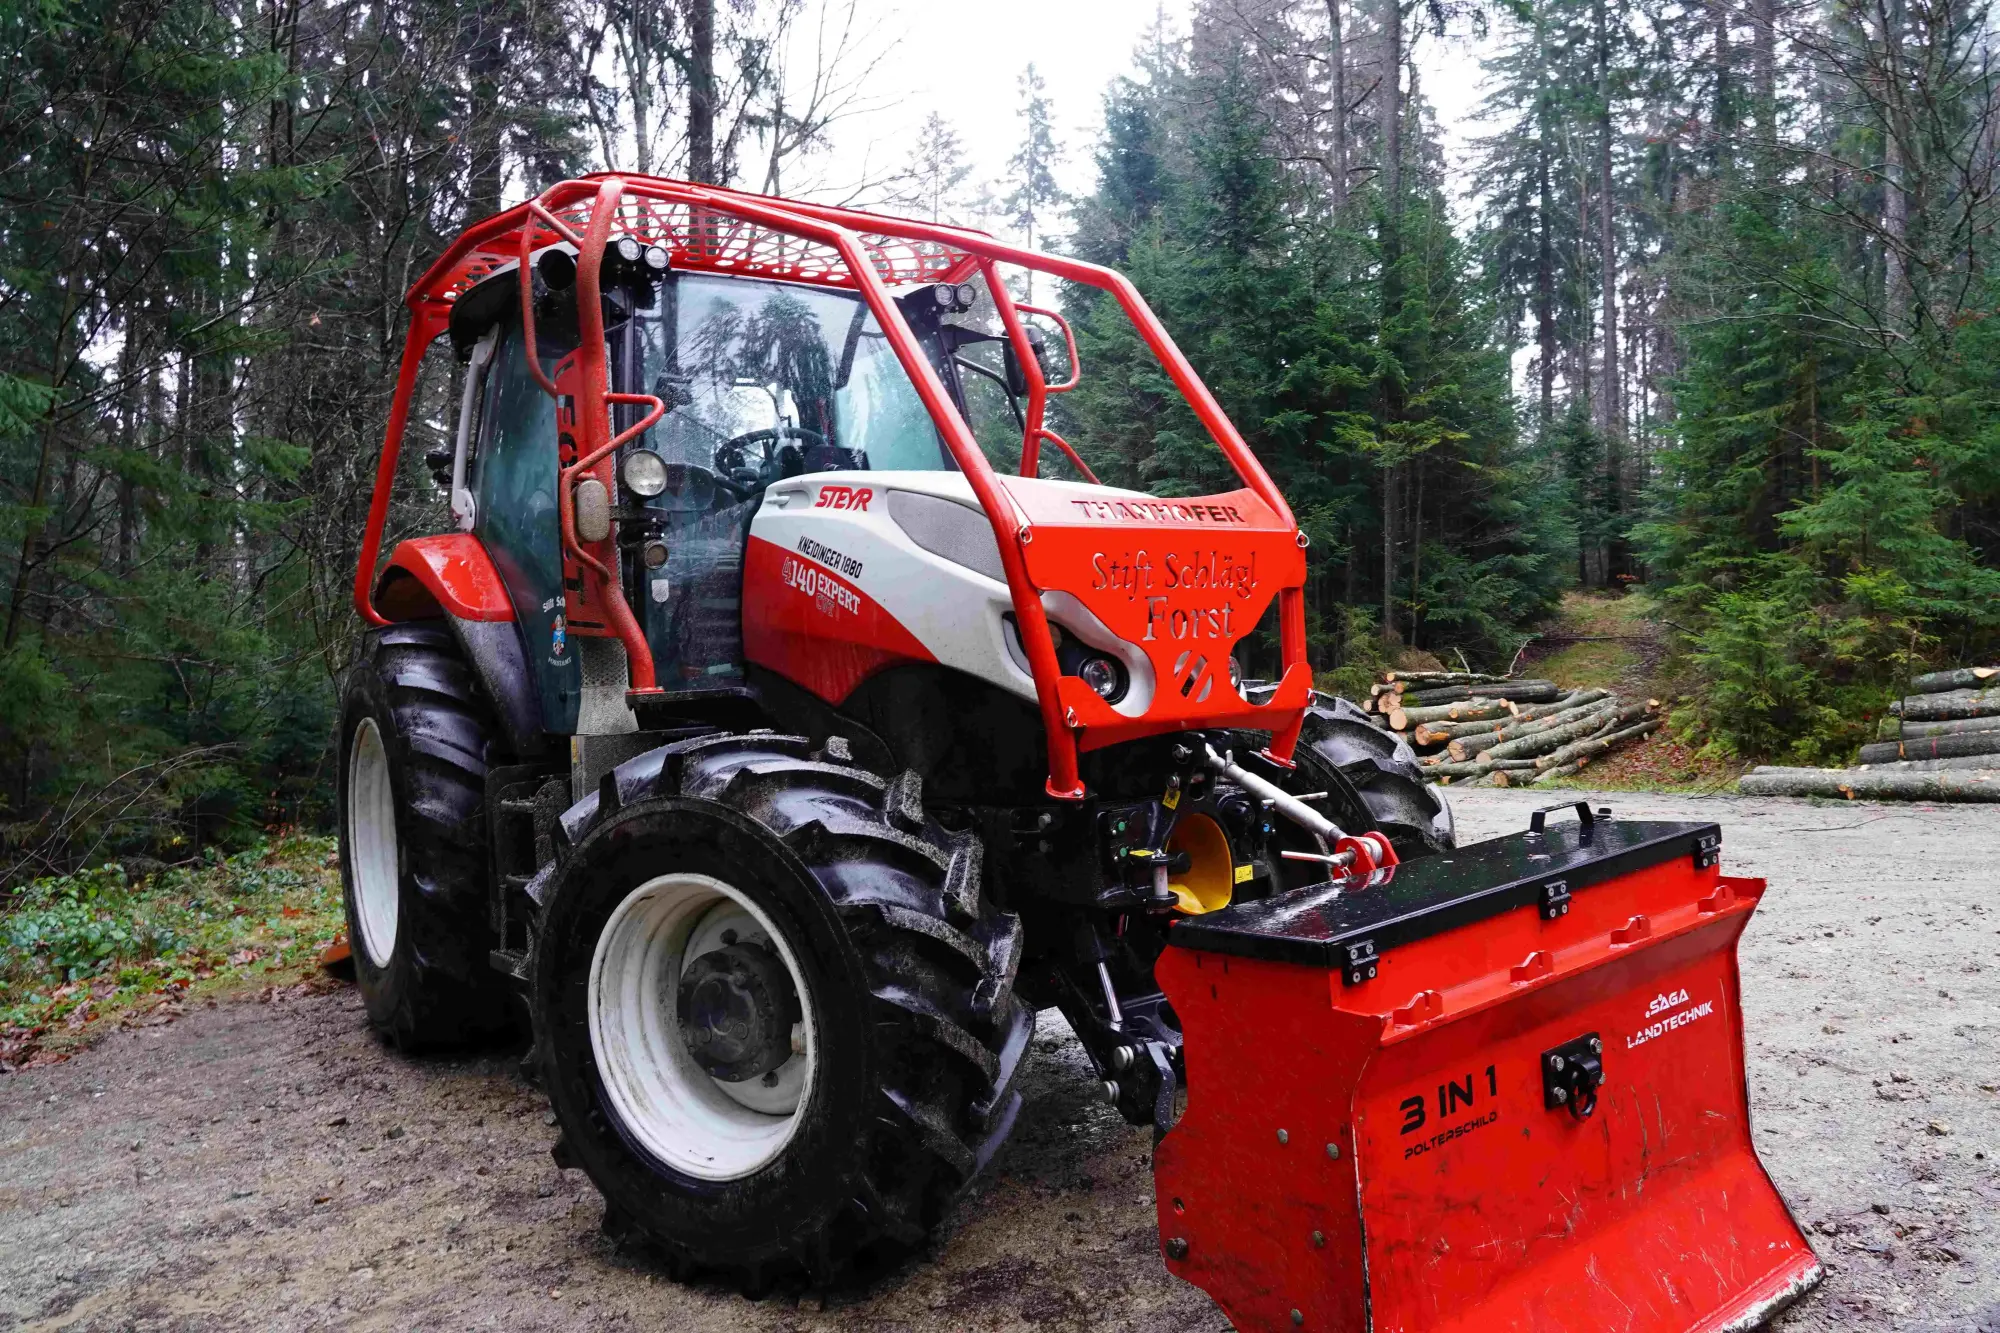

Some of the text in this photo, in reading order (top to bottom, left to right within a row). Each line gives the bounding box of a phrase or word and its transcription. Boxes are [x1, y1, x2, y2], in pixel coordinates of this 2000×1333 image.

[815, 485, 873, 512] STEYR
[1071, 500, 1246, 524] THANHOFER
[796, 535, 863, 579] KNEIDINGER 1880
[1092, 550, 1259, 602] Stift Schlägl
[817, 573, 861, 616] EXPERT
[1142, 596, 1236, 641] Forst
[1626, 1001, 1714, 1049] LANDTECHNIK
[1399, 1064, 1498, 1136] 3 IN 1
[1404, 1112, 1498, 1160] POLTERSCHILD
